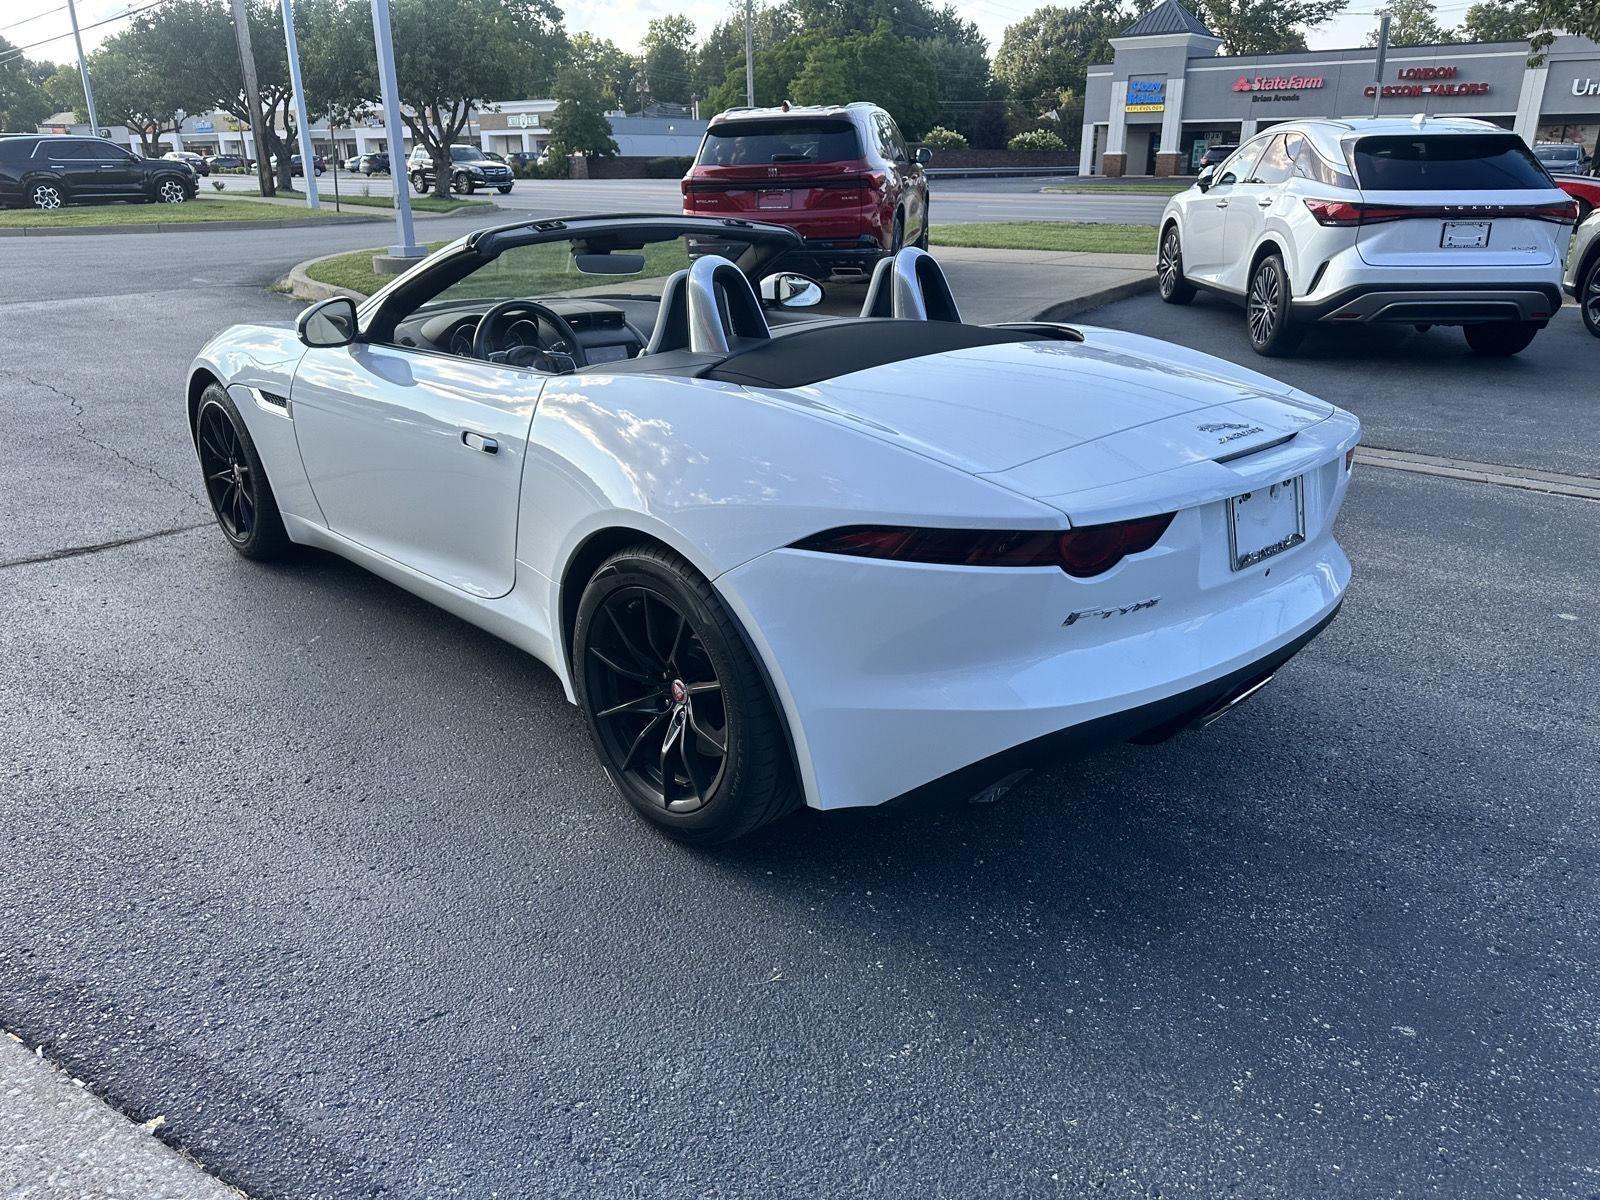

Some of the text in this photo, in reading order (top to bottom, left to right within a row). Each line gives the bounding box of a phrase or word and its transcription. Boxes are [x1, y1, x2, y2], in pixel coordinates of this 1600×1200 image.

[1398, 67, 1457, 80] LONDON
[1429, 83, 1489, 96] TAILORS
[1571, 78, 1600, 96] Ur
[1273, 94, 1300, 102] Arends
[1218, 426, 1264, 444] JAGUAR
[1257, 539, 1289, 563] JAGUAR
